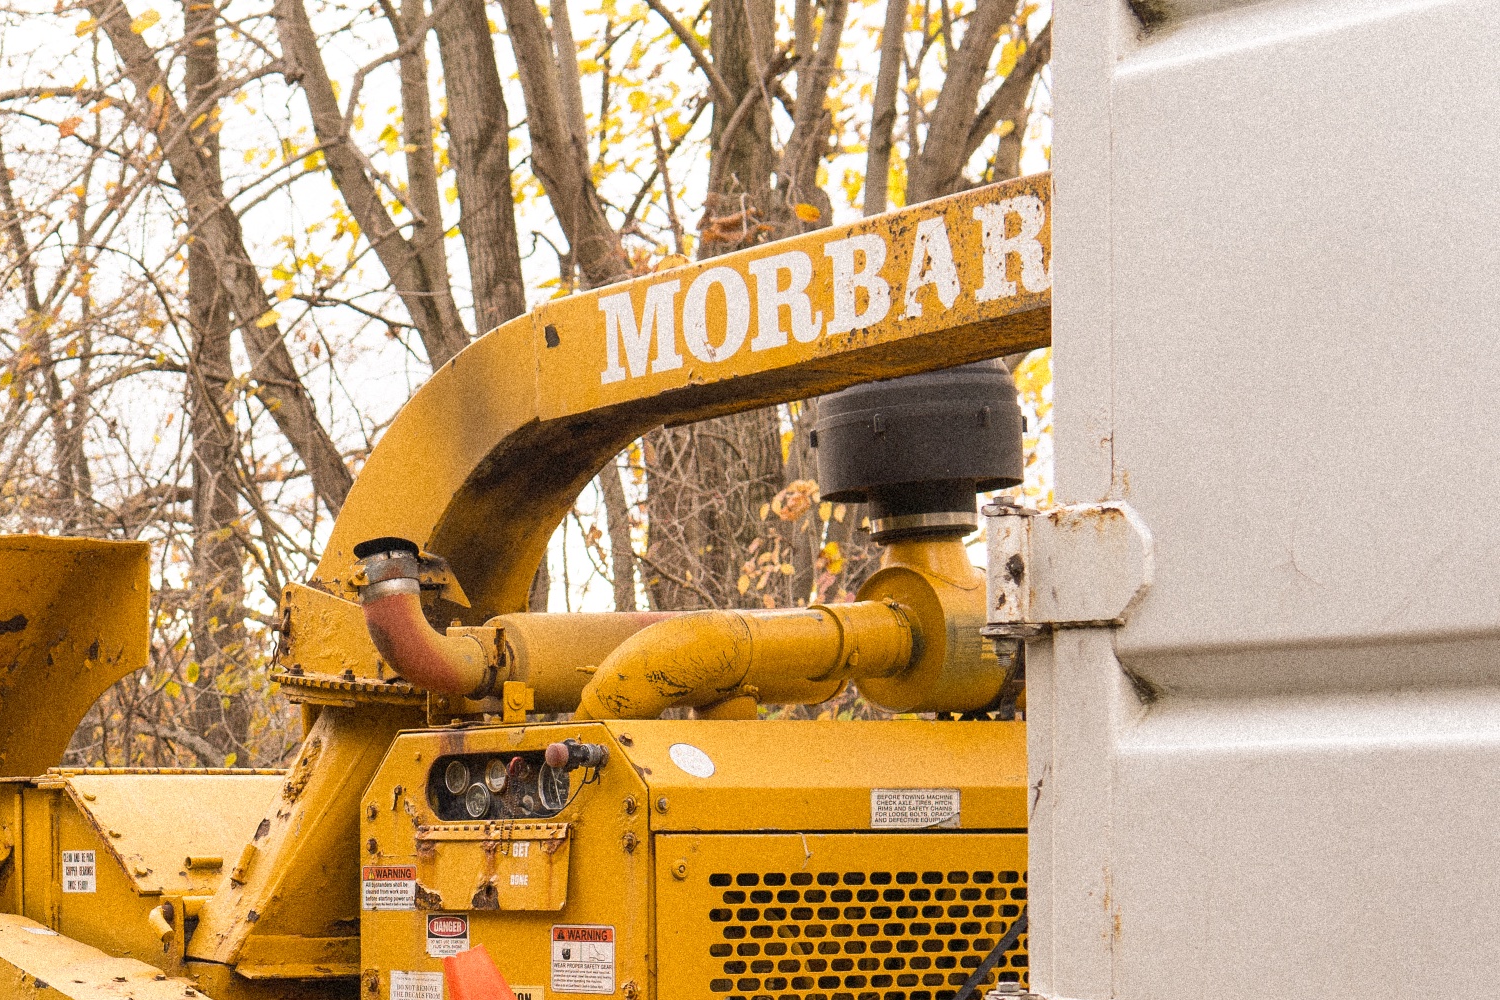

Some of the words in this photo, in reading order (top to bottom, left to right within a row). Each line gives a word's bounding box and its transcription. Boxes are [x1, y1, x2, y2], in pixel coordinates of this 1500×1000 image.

[598, 195, 1051, 385] MORBAR
[512, 842, 530, 857] GET
[376, 869, 411, 878] WARNING
[434, 921, 462, 932] DANGER
[568, 930, 607, 940] WARNING
